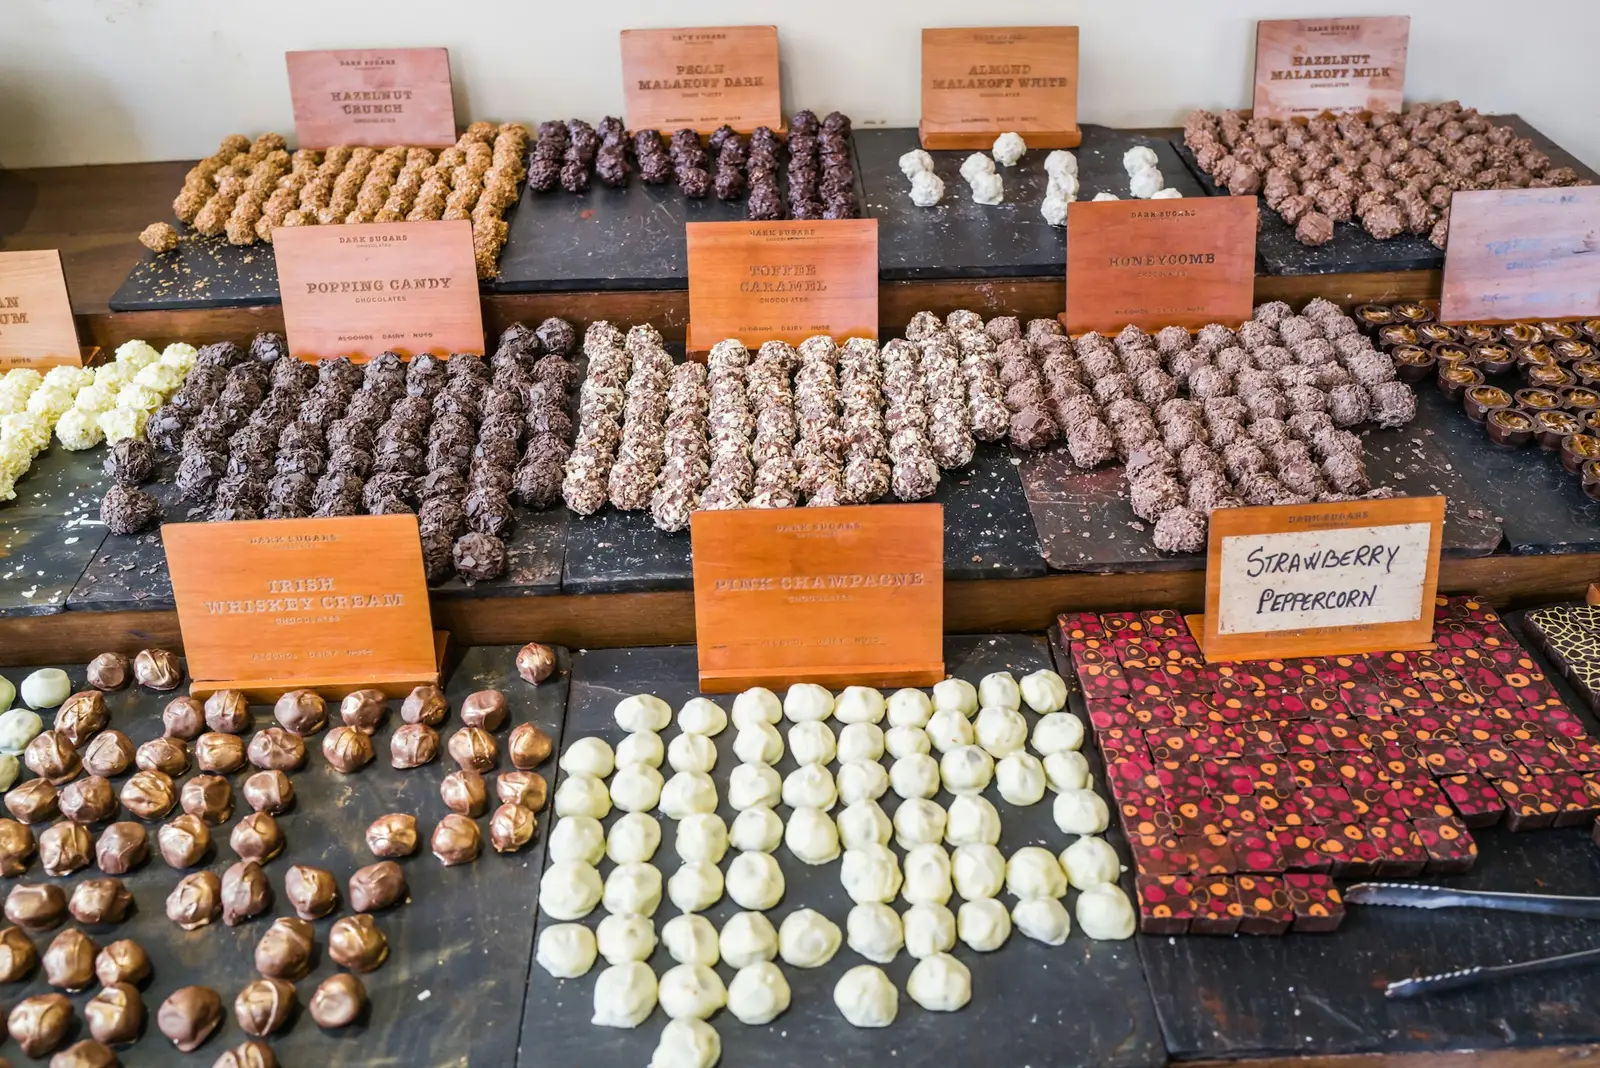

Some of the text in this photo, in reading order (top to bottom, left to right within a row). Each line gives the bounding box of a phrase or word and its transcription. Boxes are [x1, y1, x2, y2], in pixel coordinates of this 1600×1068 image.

[1292, 54, 1371, 66] HAZELNUT
[676, 64, 725, 76] PECAN
[968, 64, 1031, 76] ALMOND
[1270, 67, 1390, 80] MALAKOFF MILK
[638, 76, 764, 90] MALAKOFF DARK
[932, 77, 1068, 90] MALAKOFF WHITE
[331, 90, 412, 102] HAZELNUT
[342, 104, 404, 115] CRUNCH
[369, 234, 408, 242] SUGARS
[1109, 253, 1215, 268] HONEYCOMB
[750, 264, 817, 276] TOFFEE
[306, 277, 452, 294] POPPING CANDY
[740, 280, 827, 293] CARAMEL
[355, 296, 407, 304] CHOCOLATES
[776, 524, 808, 532] DARK
[288, 534, 336, 542] SUGARS
[1246, 544, 1400, 578] STRAWBERRY
[267, 578, 336, 594] IRISH
[714, 572, 924, 593] PINK CHAMPAGNE
[204, 594, 404, 614] WHISKEY CREAM
[1256, 584, 1378, 614] PEPPERCORN
